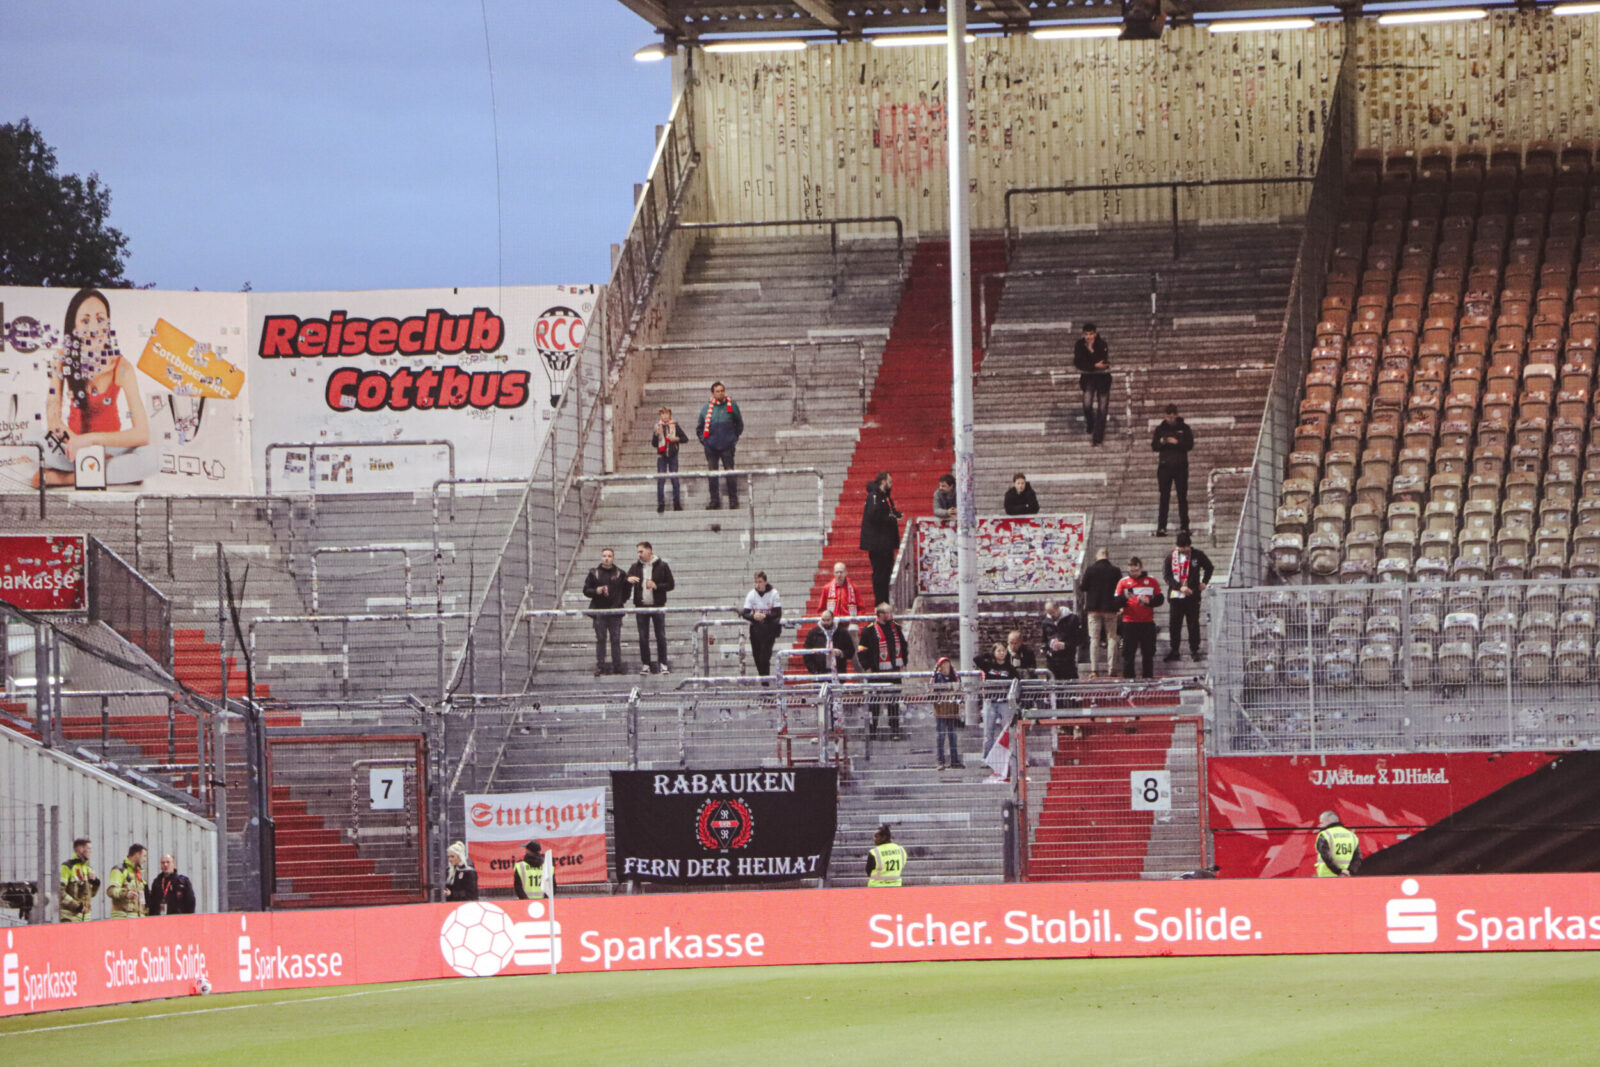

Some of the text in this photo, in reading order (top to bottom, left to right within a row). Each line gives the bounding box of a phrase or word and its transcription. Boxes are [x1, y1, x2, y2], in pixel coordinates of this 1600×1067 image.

[258, 307, 505, 359] Reiseclub
[536, 318, 583, 351] RCC
[326, 366, 531, 411] Cottbus
[0, 570, 74, 589] arkasse
[381, 779, 393, 799] 7
[654, 772, 796, 796] RABAUKEN
[1143, 777, 1159, 803] 8
[1378, 768, 1390, 784] &
[471, 797, 601, 831] Stuttgart
[490, 855, 523, 870] ewi
[1335, 843, 1352, 855] 264
[624, 855, 820, 877] FERN DER HEIMAT
[885, 859, 900, 871] 121
[869, 907, 1262, 948] Sicher. Stabil. Solide.
[580, 926, 764, 969] Sparkasse
[105, 944, 208, 988] Sicher. Stabil. Solide.
[254, 946, 343, 988] Sparkasse
[23, 962, 77, 1009] Sparkasse
